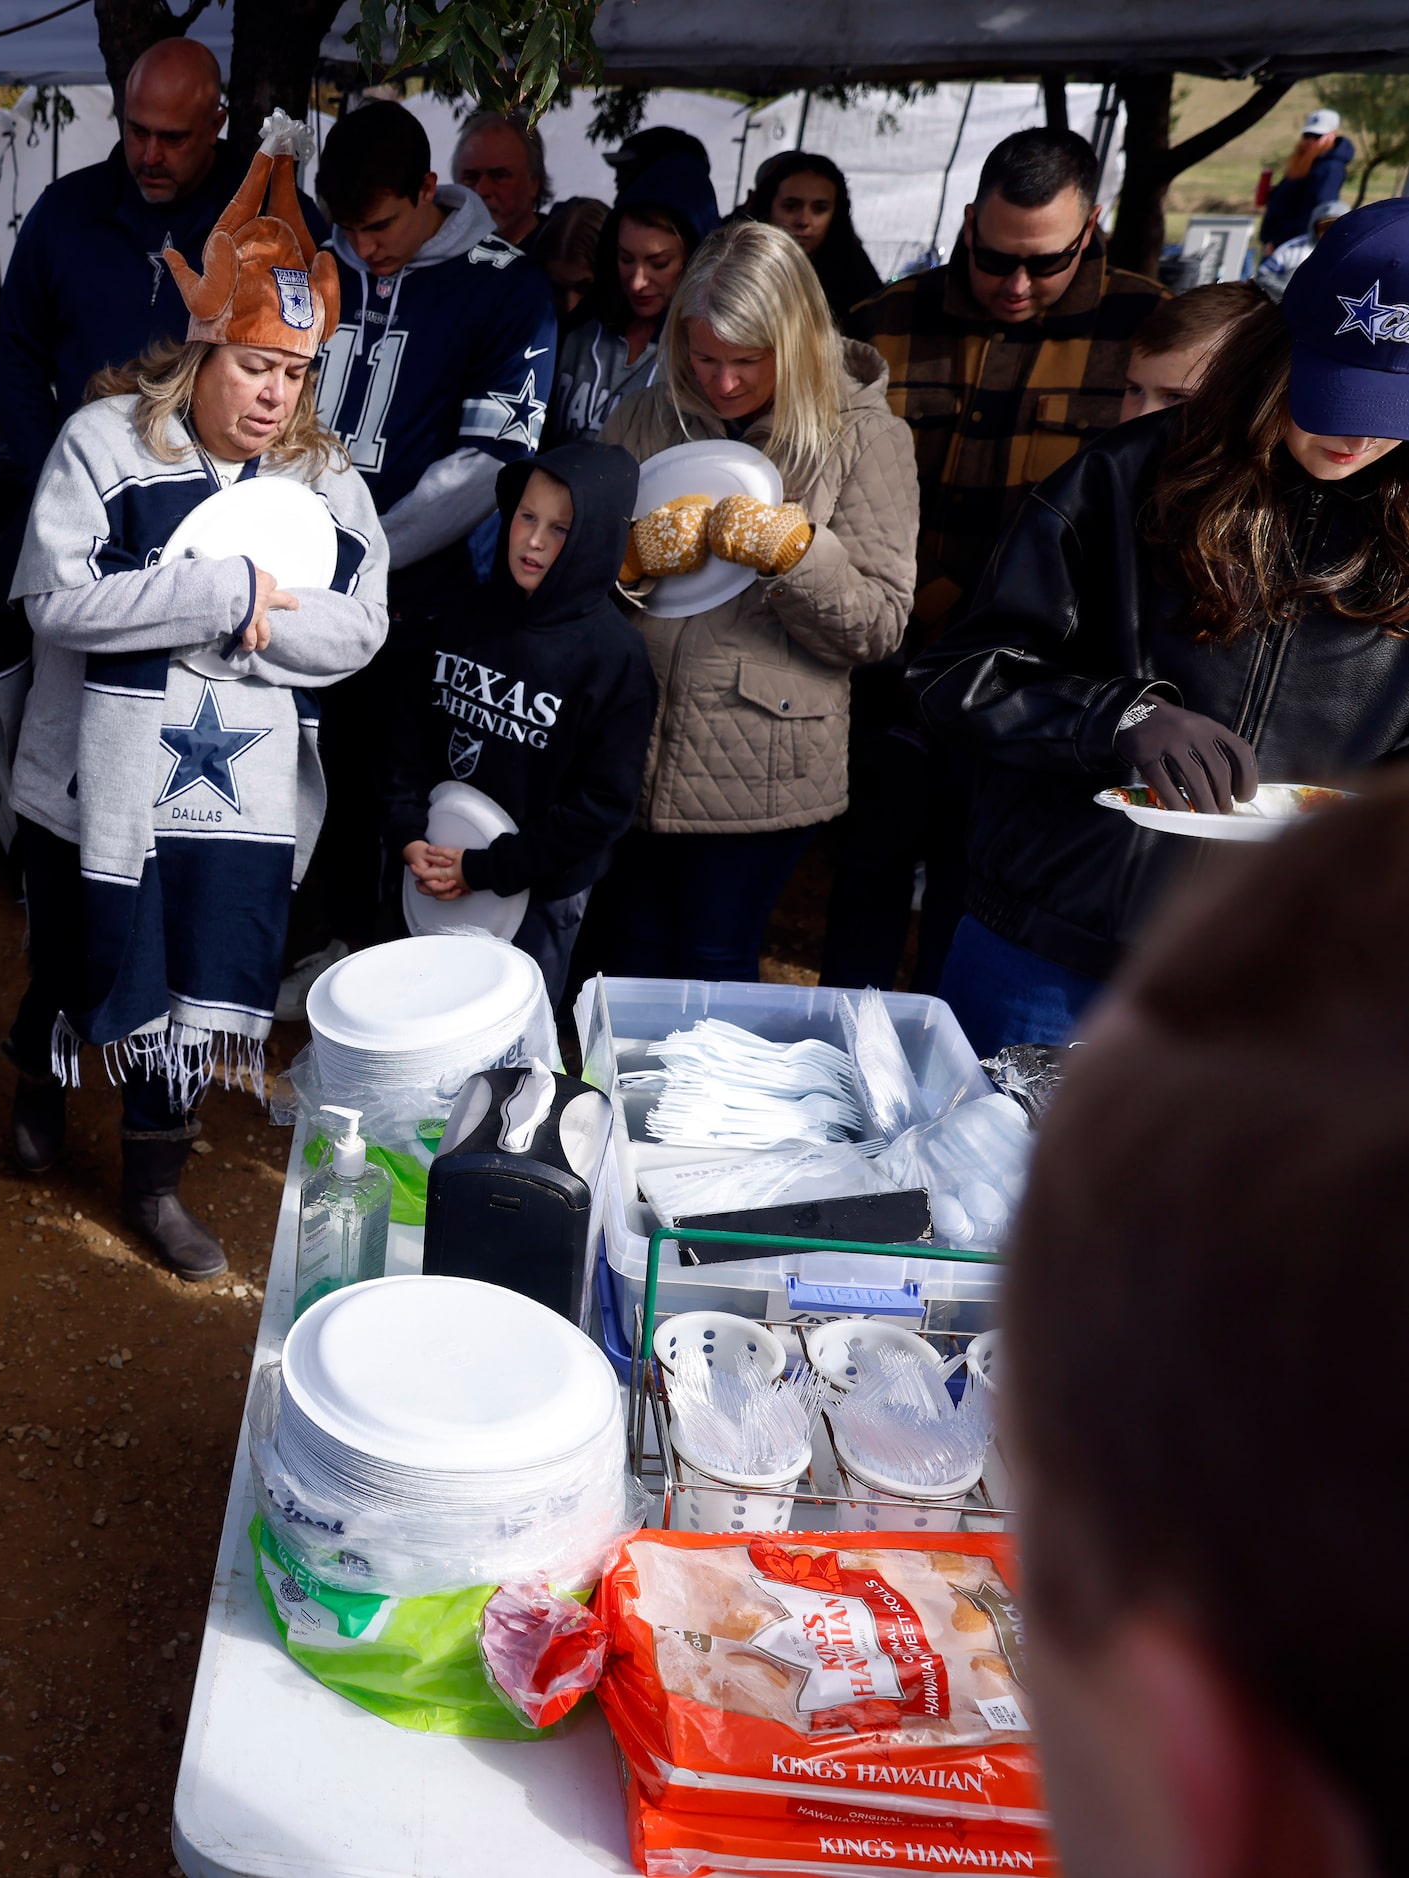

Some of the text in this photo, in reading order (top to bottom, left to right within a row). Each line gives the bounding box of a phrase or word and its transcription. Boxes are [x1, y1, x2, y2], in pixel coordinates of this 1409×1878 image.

[314, 323, 409, 474] 11
[432, 650, 562, 728] TEXAS
[432, 687, 549, 750] LIHTNING
[171, 807, 223, 823] DALLAS
[865, 1578, 906, 1616] ROLLS
[802, 1611, 844, 1672] KING'S
[818, 1596, 877, 1697] HAWAIIAN
[899, 1614, 924, 1658] WEET
[771, 1753, 983, 1793] KING'S HAWAIIAN
[848, 1810, 903, 1823] ORIGINAL
[818, 1836, 1035, 1870] KING'S HAWAIIAN
